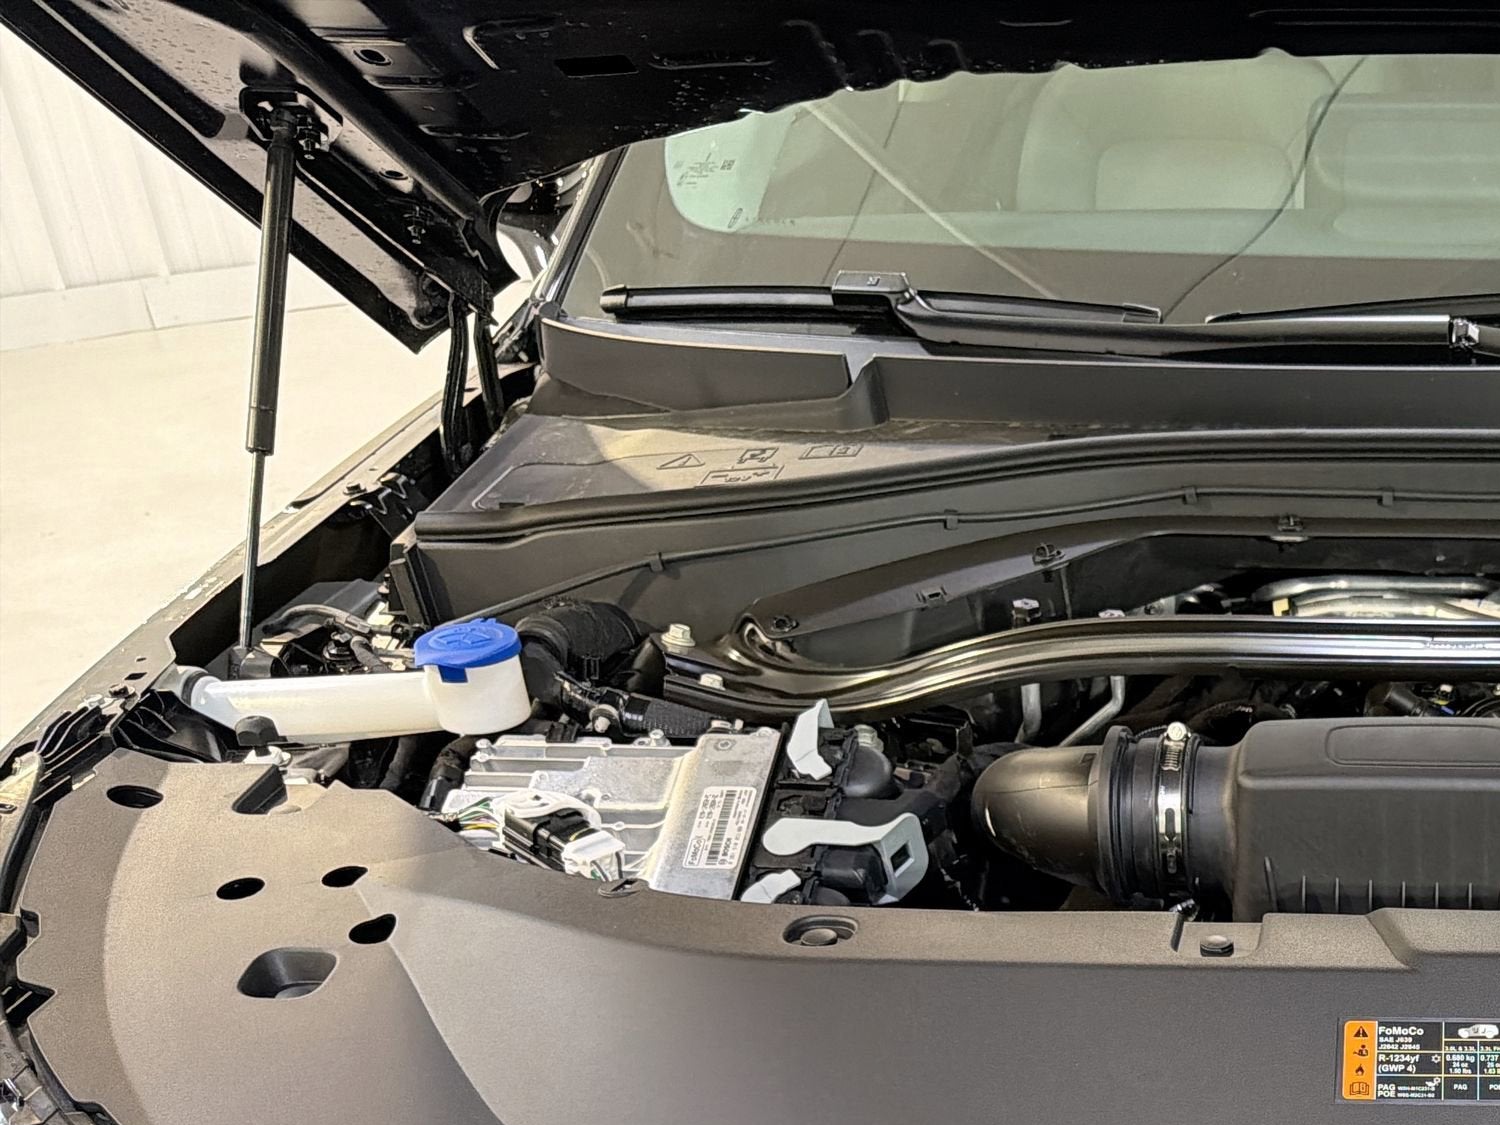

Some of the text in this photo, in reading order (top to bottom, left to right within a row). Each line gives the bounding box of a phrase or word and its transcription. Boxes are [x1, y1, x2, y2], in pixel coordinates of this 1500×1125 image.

[1378, 1026, 1424, 1036] FoMoCo
[1378, 1054, 1420, 1065] R-1234yf
[1466, 1054, 1475, 1063] kg
[1479, 1054, 1499, 1062] 0.737
[1378, 1064, 1416, 1074] (GWP 4)
